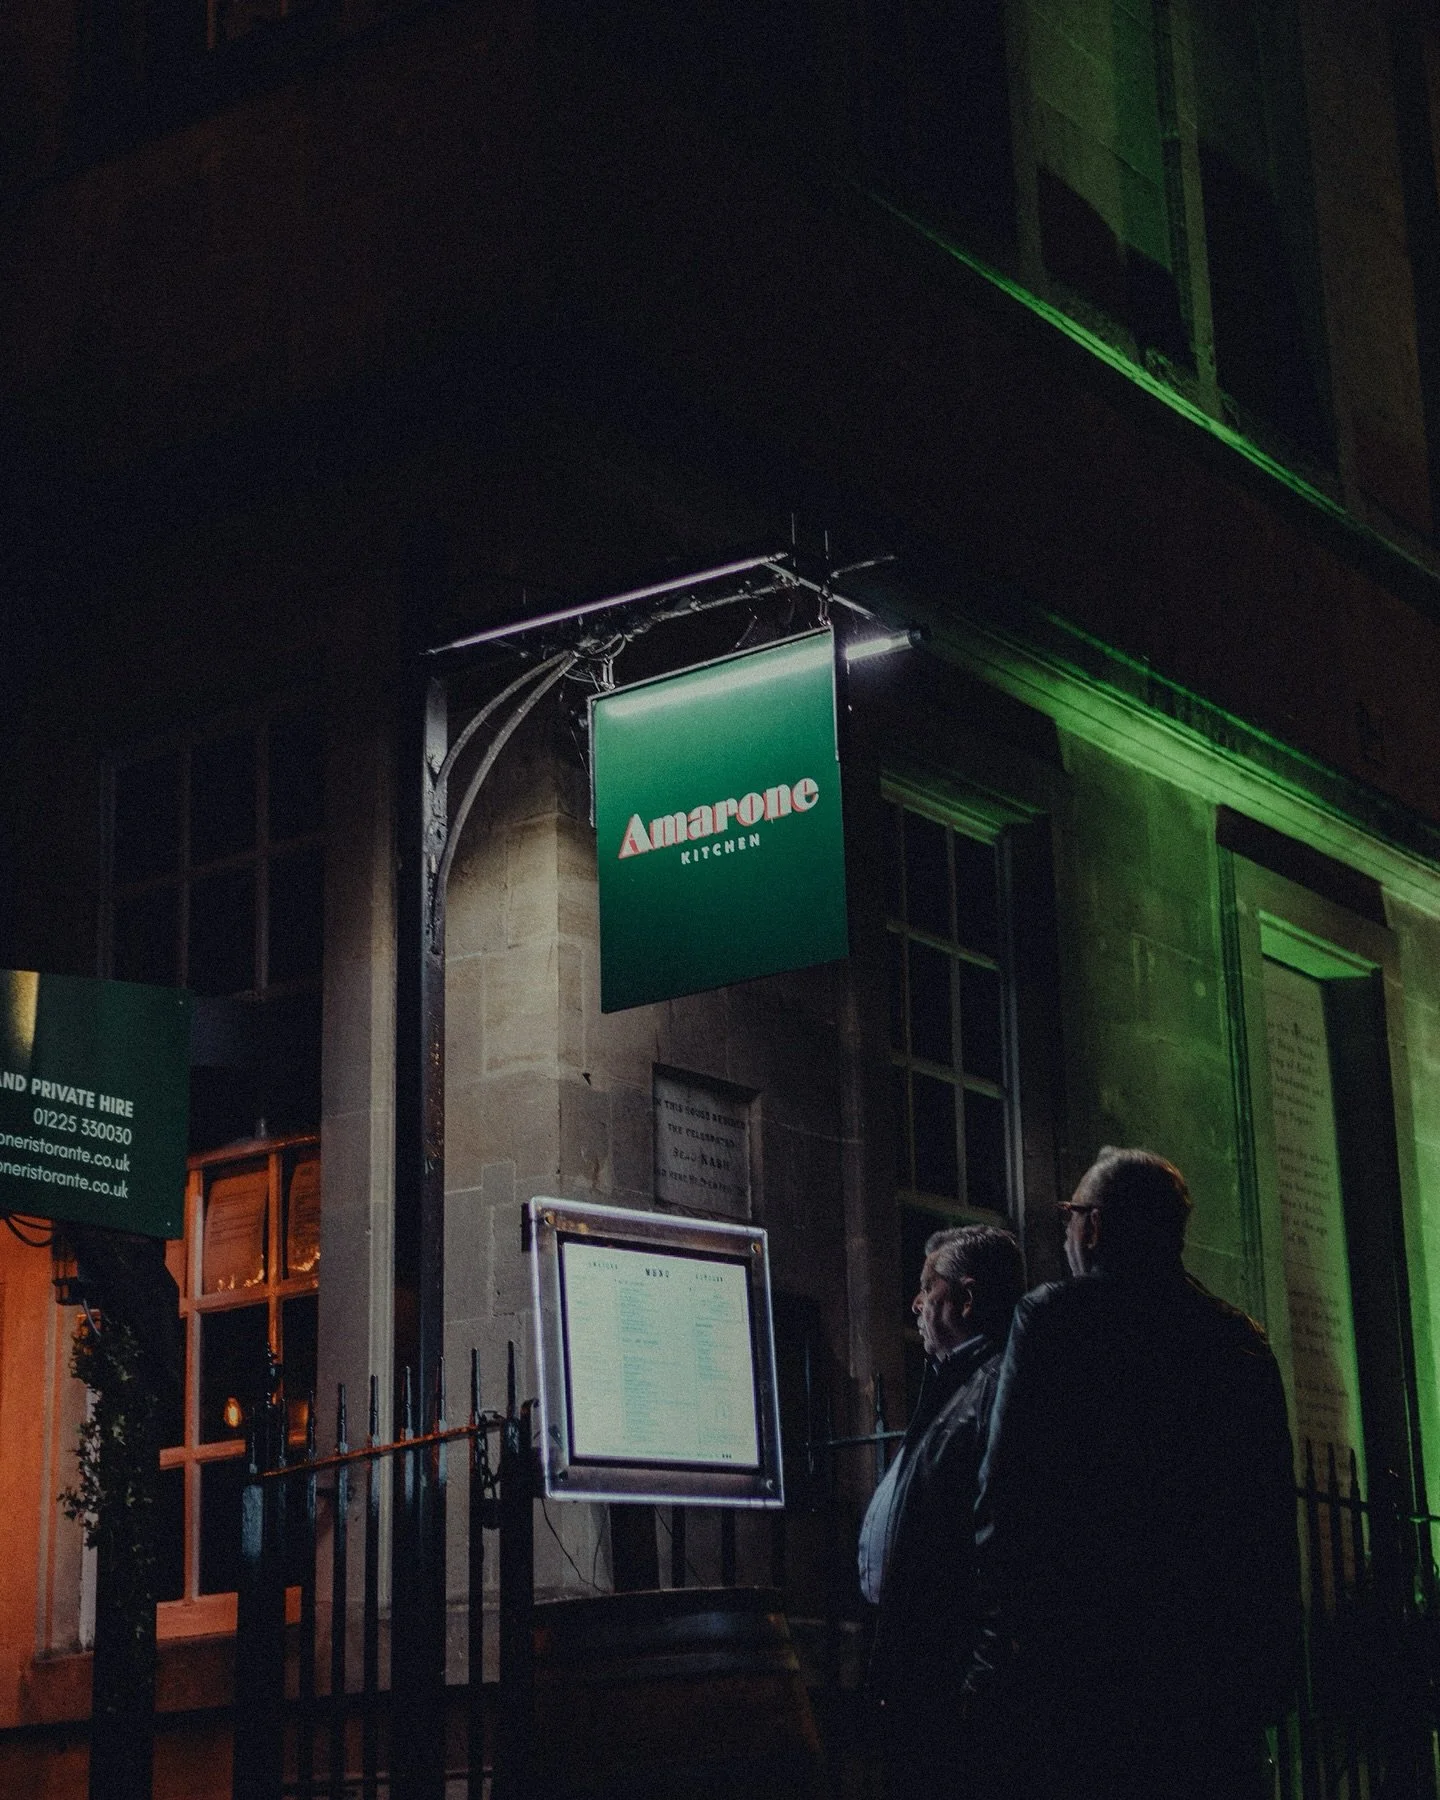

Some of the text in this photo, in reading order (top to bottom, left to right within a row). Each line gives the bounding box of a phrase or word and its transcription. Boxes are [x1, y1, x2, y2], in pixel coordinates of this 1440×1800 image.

[617, 777, 820, 860] Amarone
[680, 832, 761, 865] KITCHEN
[0, 1071, 134, 1118] ND PRIVATE HIRE
[33, 1107, 133, 1146] 01225 330030
[668, 1123, 683, 1135] THE
